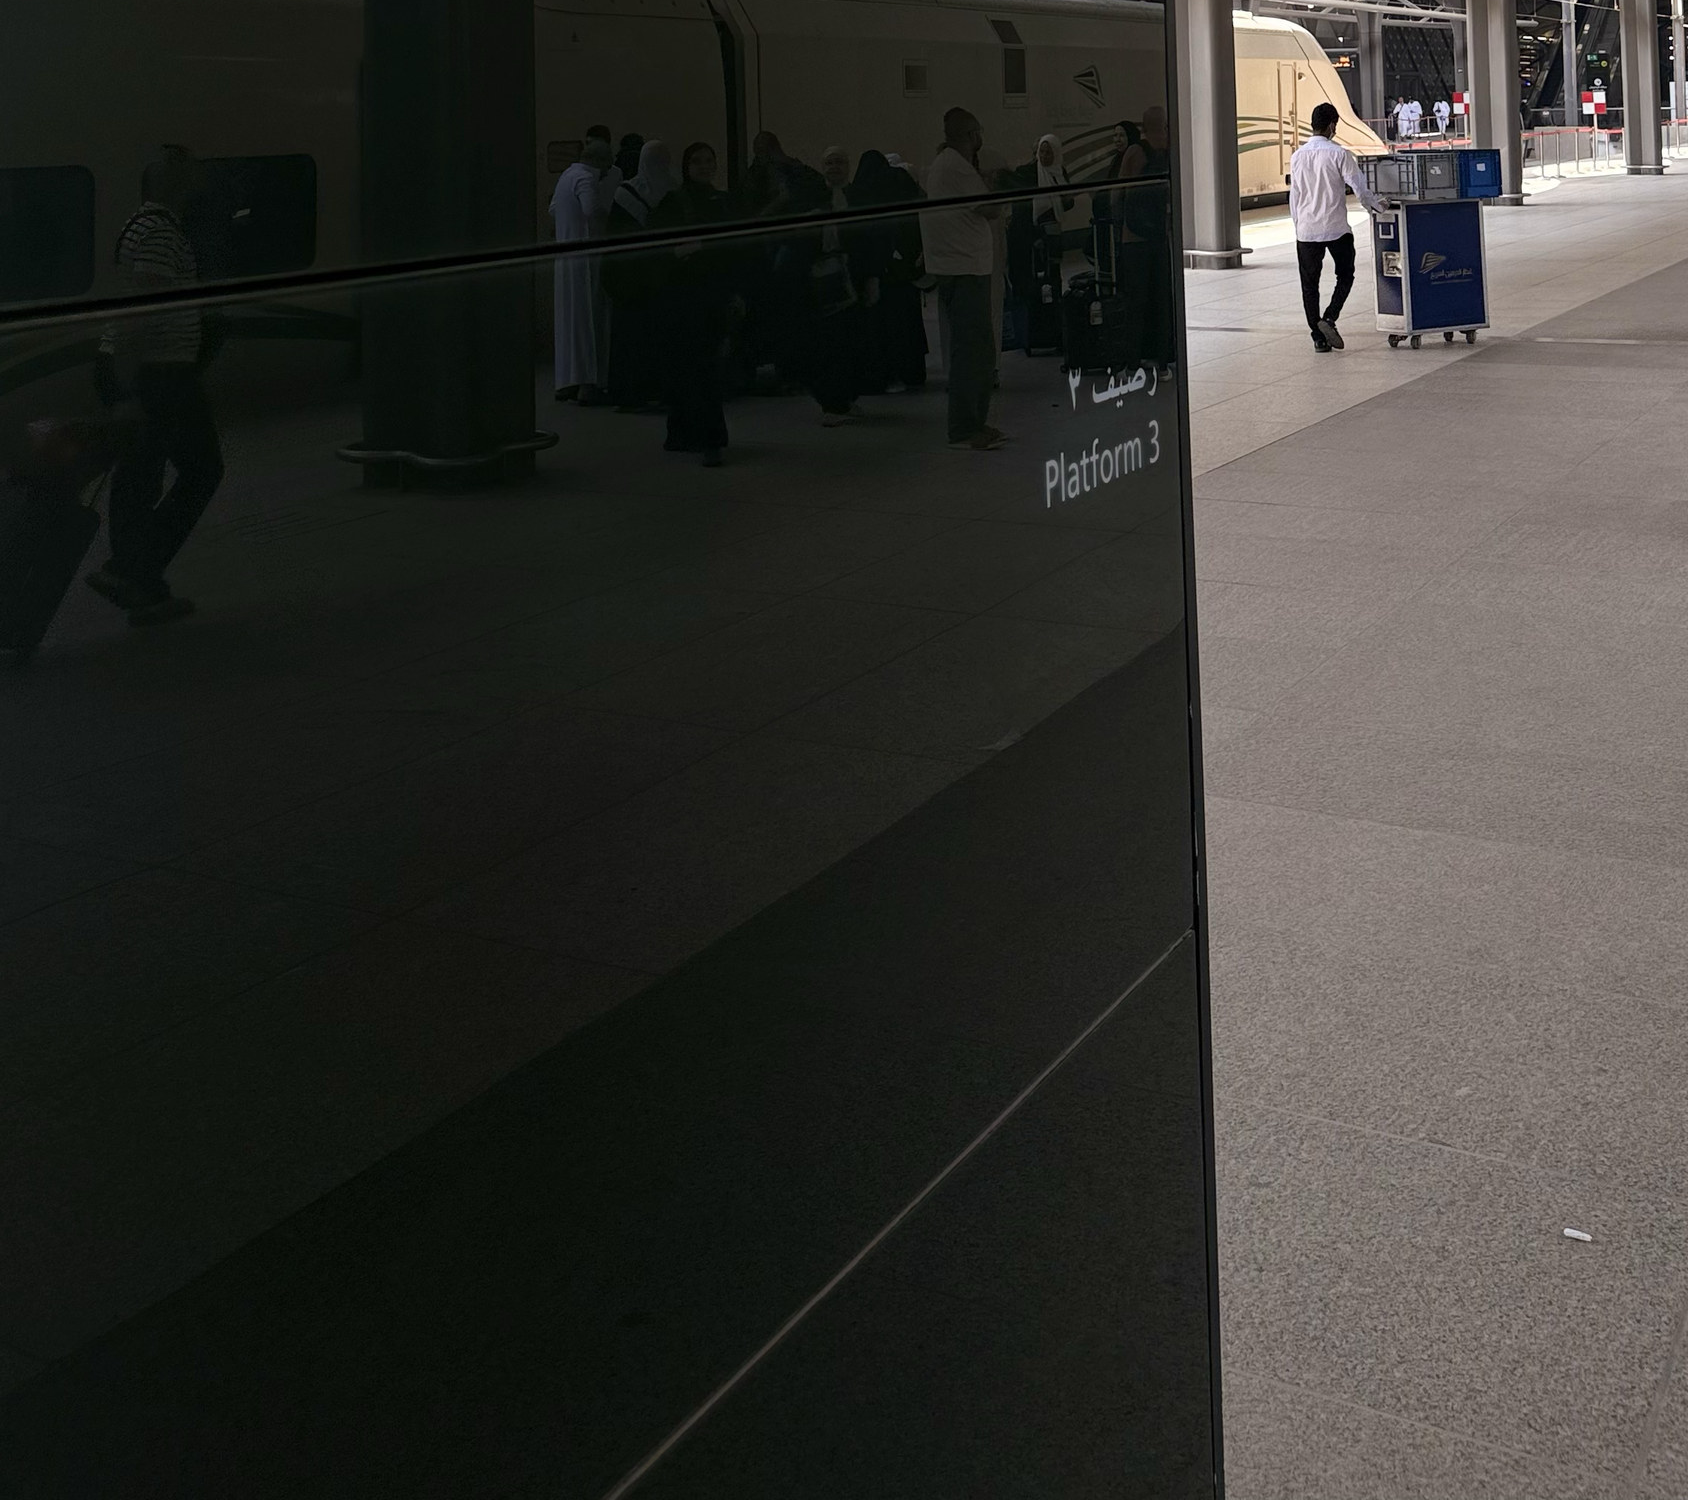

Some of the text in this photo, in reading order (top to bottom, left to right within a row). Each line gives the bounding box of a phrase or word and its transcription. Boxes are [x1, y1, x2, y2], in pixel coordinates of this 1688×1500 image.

[1068, 366, 1158, 411] رصيف ٣
[1045, 419, 1160, 509] Platform 3
